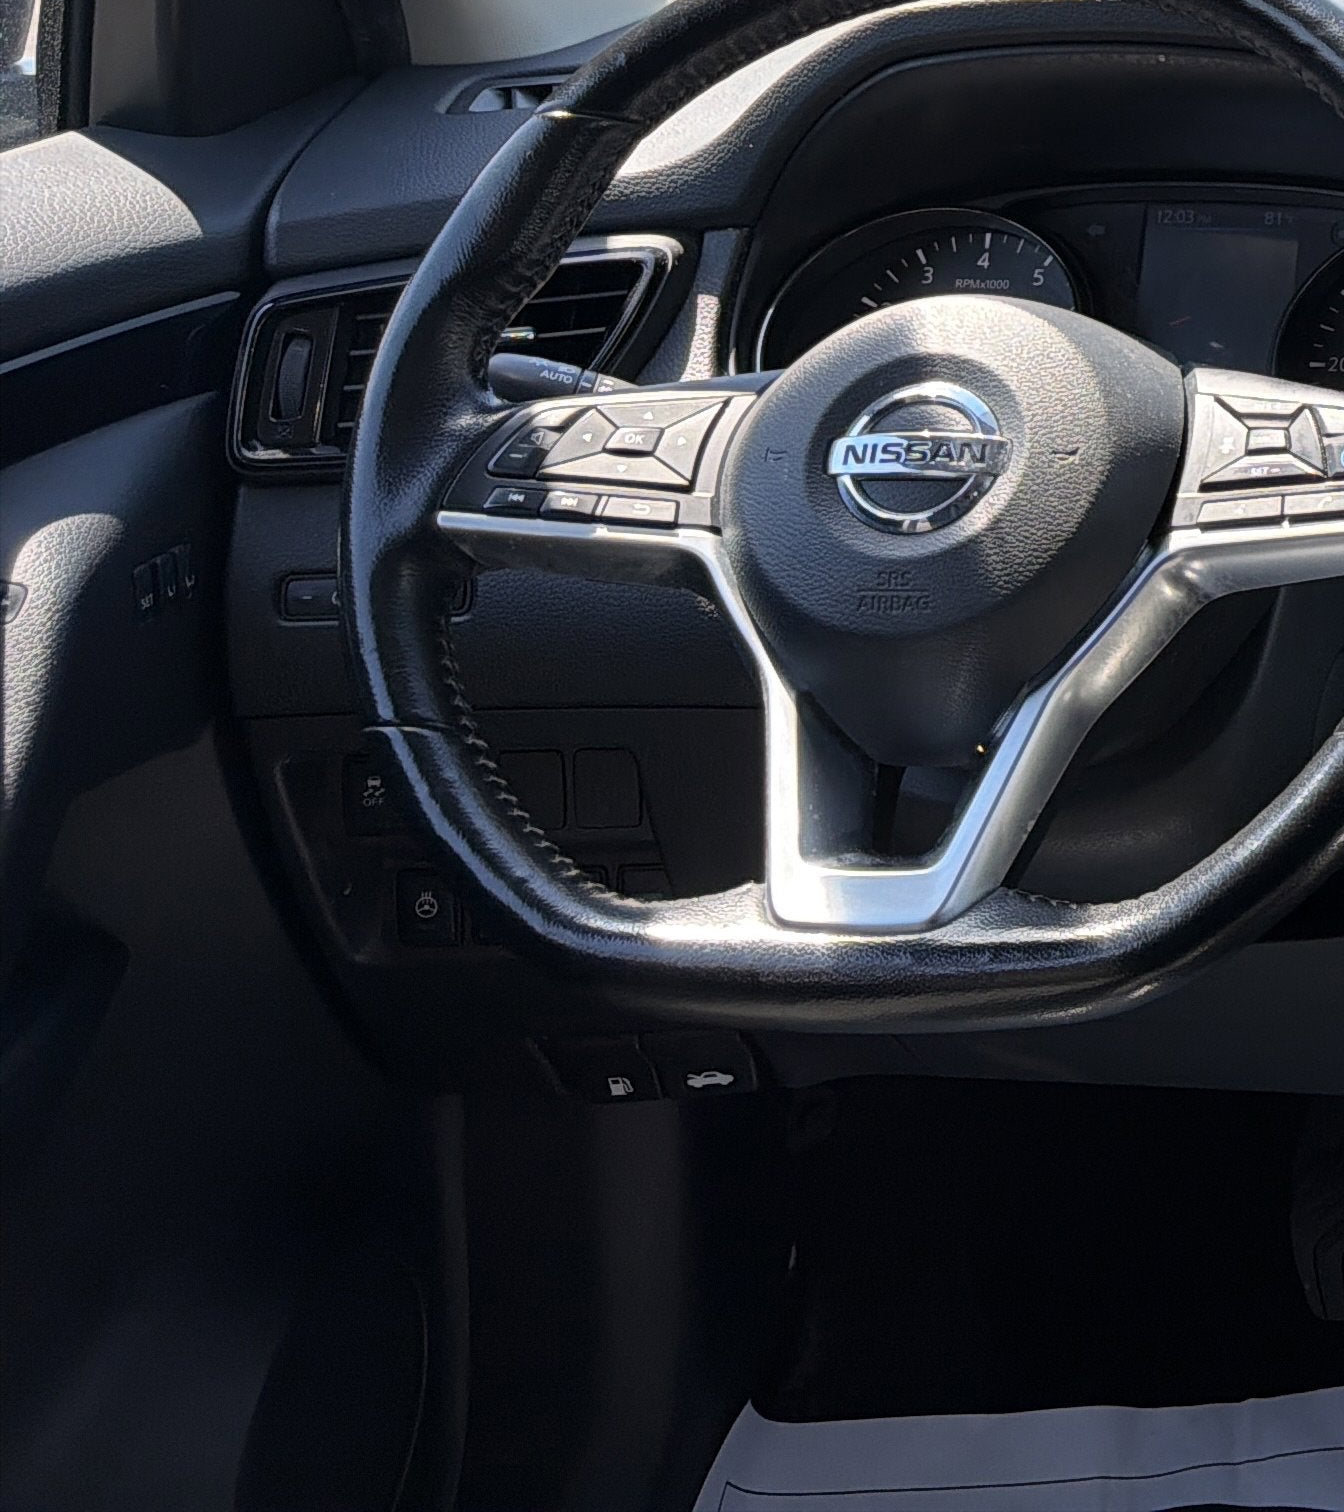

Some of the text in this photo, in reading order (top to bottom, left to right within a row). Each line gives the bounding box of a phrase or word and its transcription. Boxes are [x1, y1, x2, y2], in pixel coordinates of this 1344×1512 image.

[976, 252, 990, 270] 4
[921, 266, 935, 285] 3
[1032, 268, 1045, 287] 5
[540, 369, 574, 384] AUTO
[624, 430, 645, 446] OK
[842, 441, 990, 468] NISSAN
